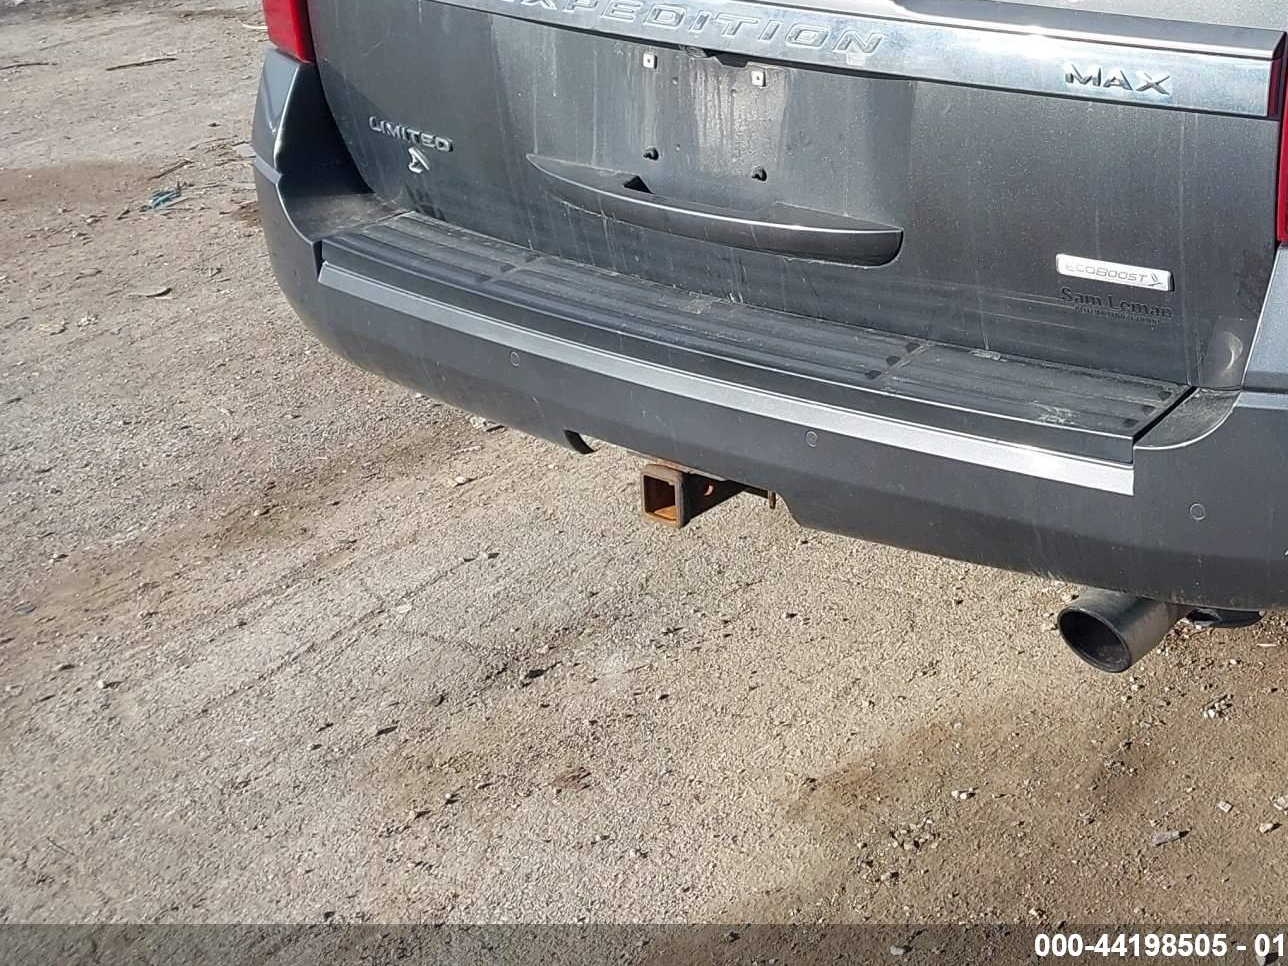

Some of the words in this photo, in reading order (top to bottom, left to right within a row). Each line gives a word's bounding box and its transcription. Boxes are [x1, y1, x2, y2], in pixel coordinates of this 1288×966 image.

[1064, 63, 1171, 96] MAX
[368, 115, 453, 153] LIMITED
[1060, 286, 1102, 307] Sam
[1107, 293, 1173, 318] Leman
